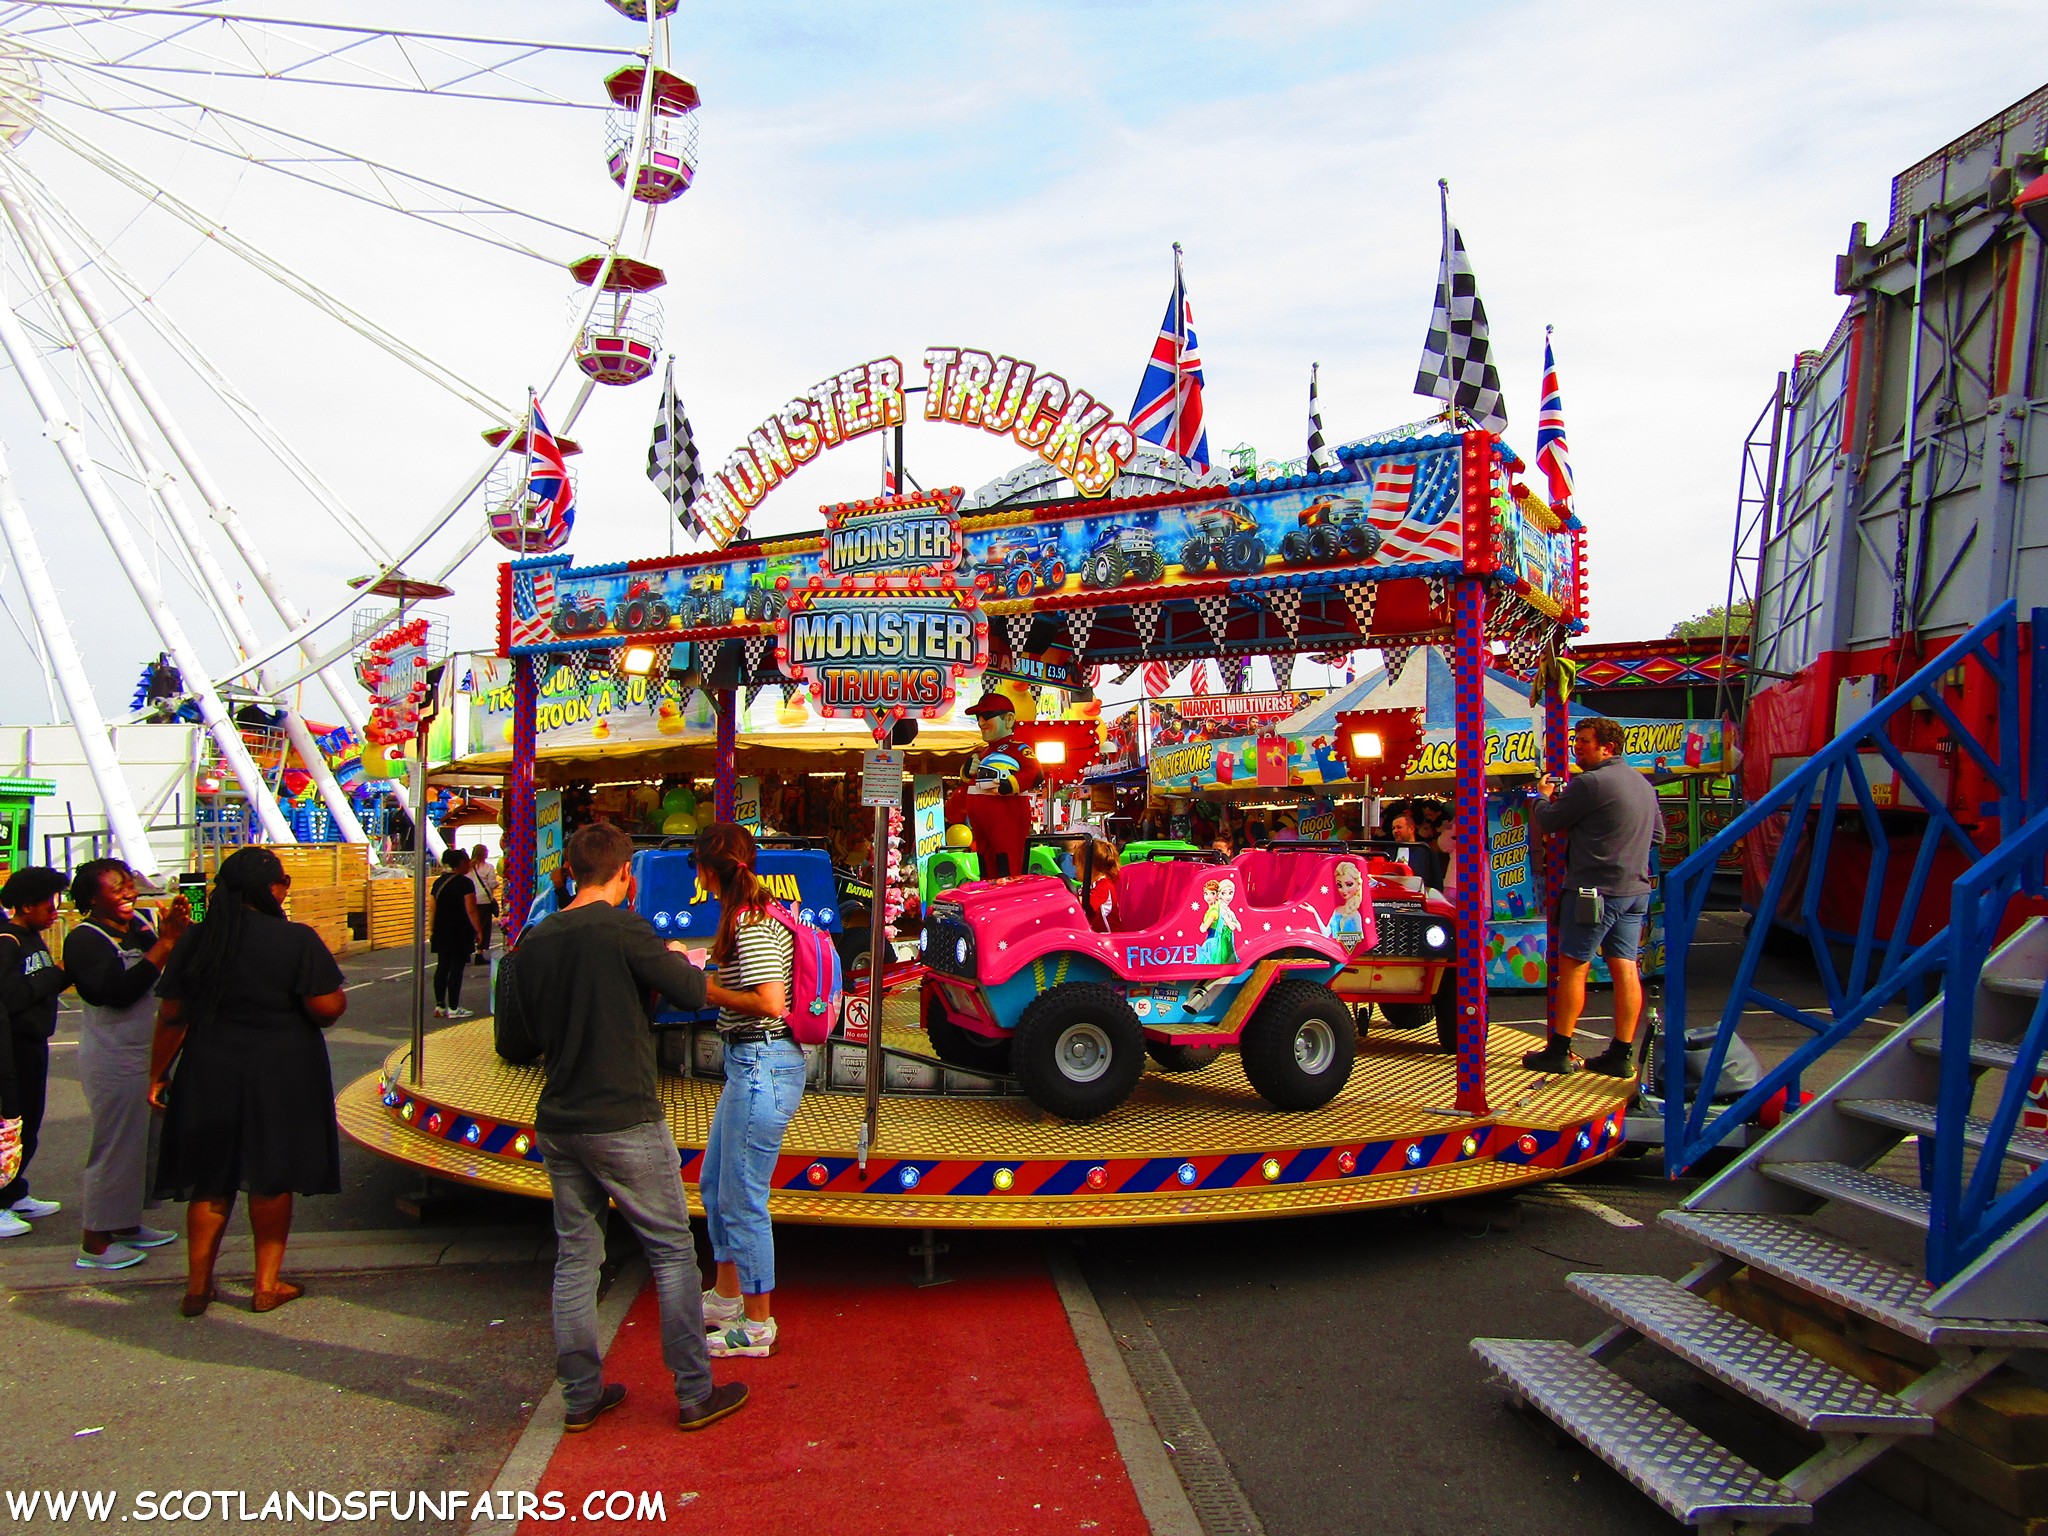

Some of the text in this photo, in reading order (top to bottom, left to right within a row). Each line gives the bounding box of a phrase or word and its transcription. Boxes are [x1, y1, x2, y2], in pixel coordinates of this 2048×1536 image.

[691, 346, 1137, 549] MONSTER TRUCKS
[832, 520, 951, 571] MONSTER
[793, 612, 976, 665] MONSTER
[1047, 665, 1066, 680] £3.50
[488, 683, 515, 713] TR
[825, 668, 942, 706] TRUCKS
[535, 693, 593, 733] HOOK
[597, 688, 612, 716] A
[1183, 696, 1293, 717] MARVEL MULTIVERSE
[1166, 742, 1213, 778] EVERYONE
[916, 785, 941, 812] HOOK
[538, 802, 560, 829] HOOK
[926, 811, 934, 831] A
[1301, 814, 1335, 835] HOOK
[1503, 809, 1514, 827] A
[546, 829, 554, 849] A
[918, 831, 944, 857] DUCK
[1493, 826, 1525, 850] PRIZE
[539, 851, 561, 876] DUCK
[1492, 845, 1528, 870] EVERY
[1498, 866, 1525, 889] TIME
[1126, 944, 1211, 969] FROZEN
[847, 1030, 856, 1038] No
